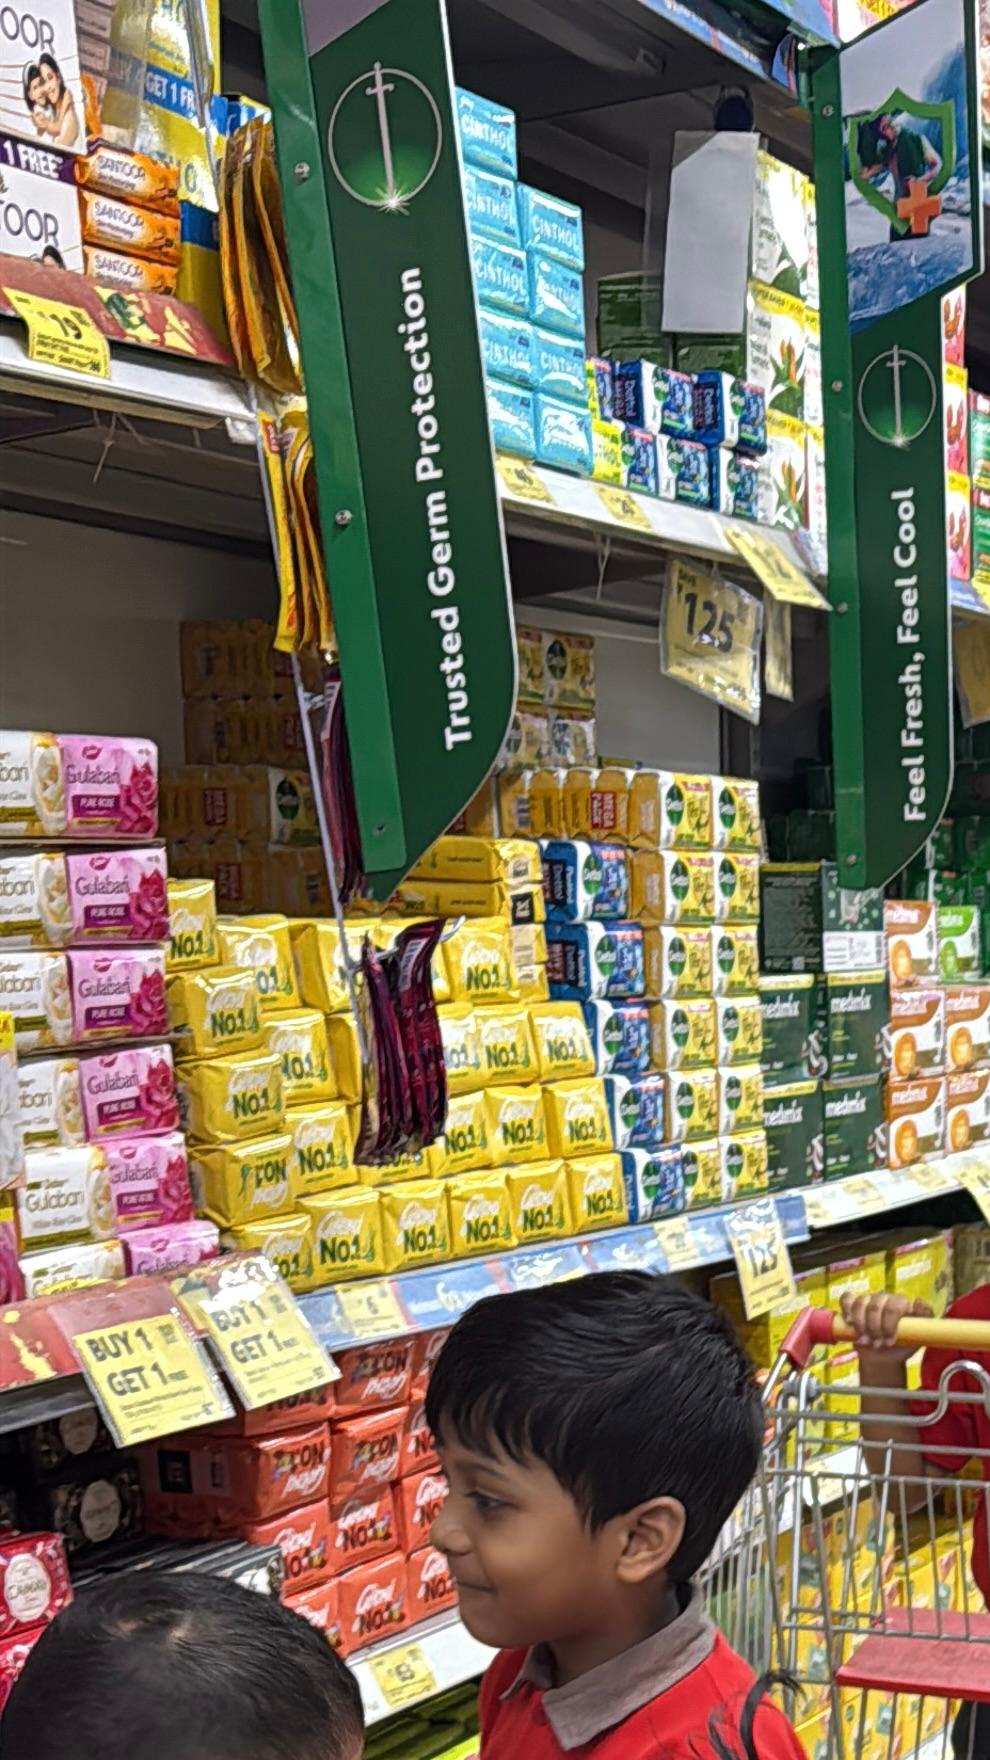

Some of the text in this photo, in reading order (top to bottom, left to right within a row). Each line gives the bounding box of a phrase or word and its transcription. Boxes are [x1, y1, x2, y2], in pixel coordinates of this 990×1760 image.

[0, 6, 55, 50] OOR
[20, 143, 63, 176] FREE
[3, 203, 59, 248] OOR
[398, 266, 473, 752] Trusted Germ Protection
[891, 486, 927, 822] Feel Fresh, Feel Cool
[75, 874, 130, 896] Gulabari
[78, 975, 131, 999] Gulabari
[87, 1070, 140, 1095] Gulabari
[85, 1326, 154, 1362] BUY 1
[230, 1334, 267, 1364] GET
[266, 1328, 284, 1353] 1
[106, 1365, 150, 1397] GET
[151, 1361, 168, 1386] 1
